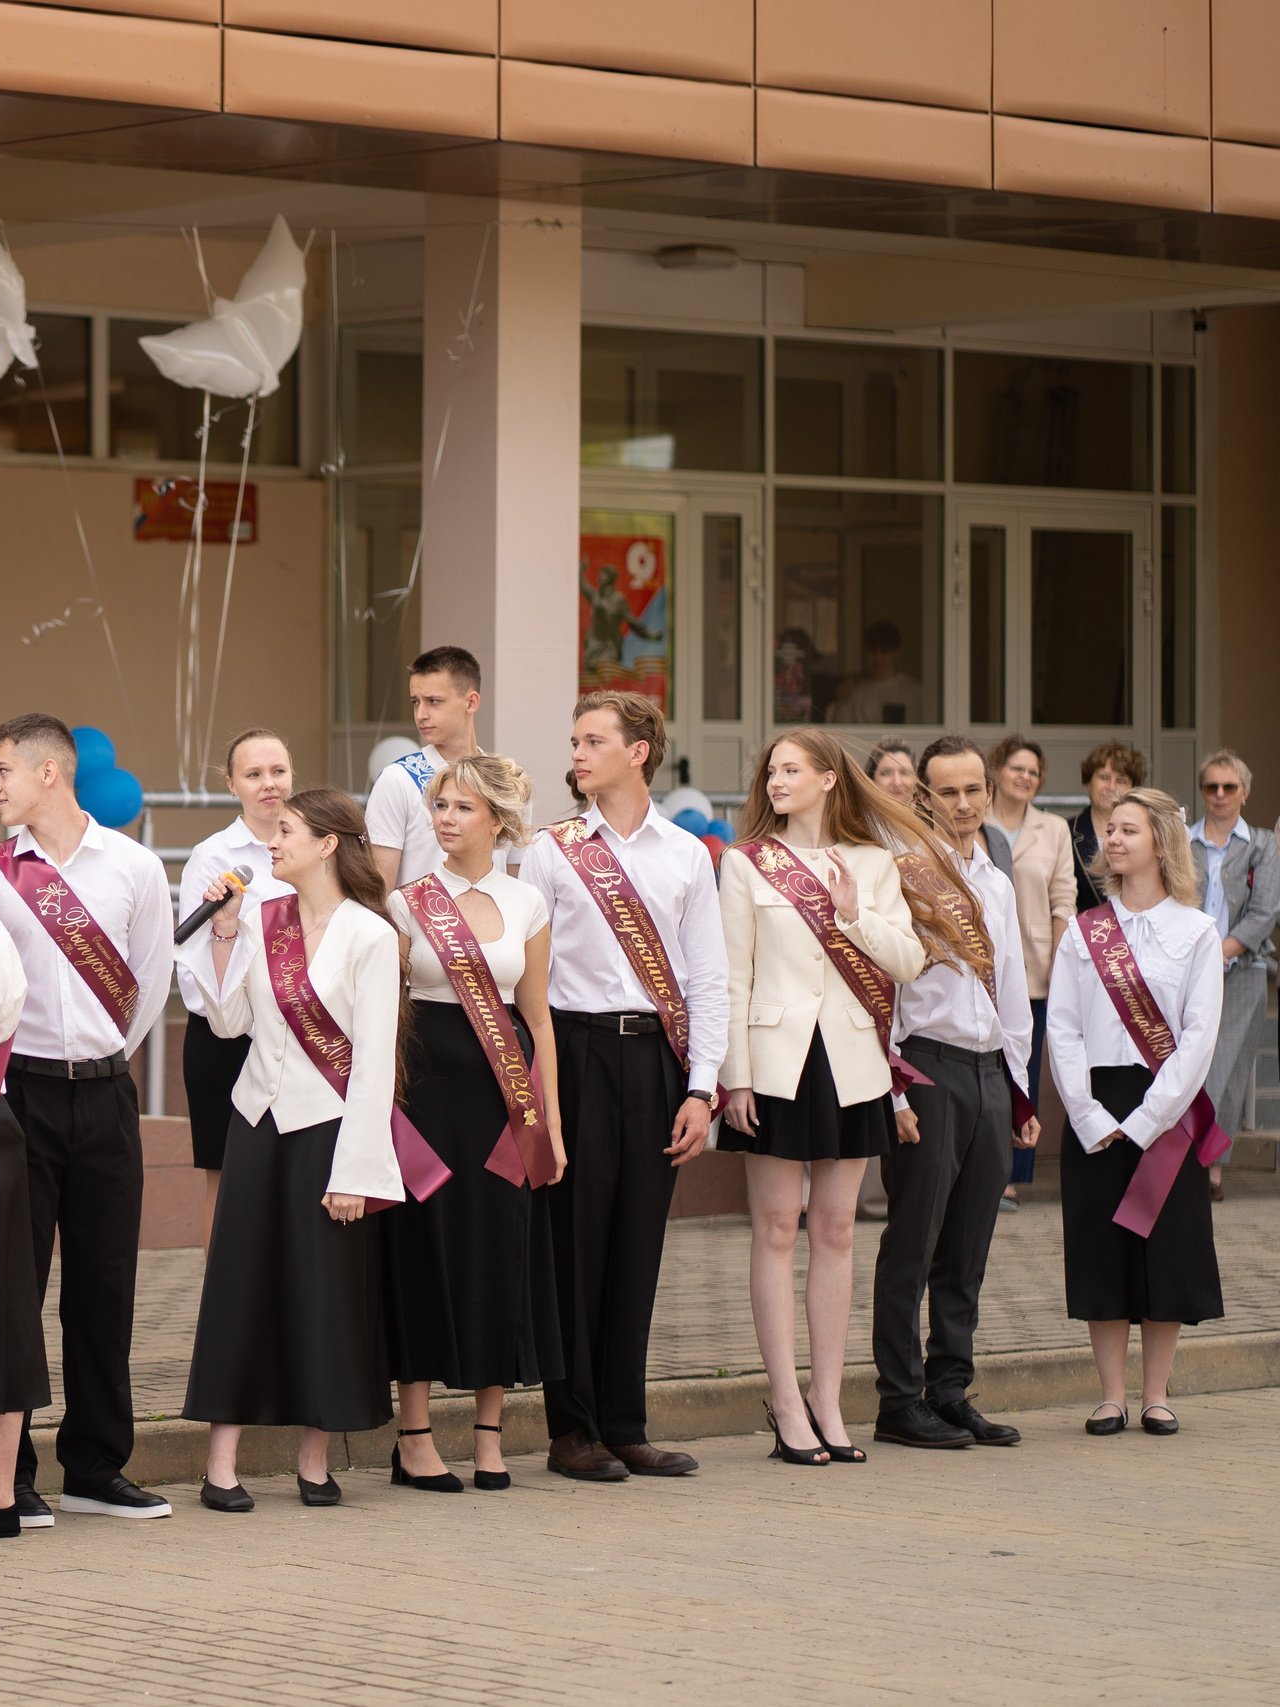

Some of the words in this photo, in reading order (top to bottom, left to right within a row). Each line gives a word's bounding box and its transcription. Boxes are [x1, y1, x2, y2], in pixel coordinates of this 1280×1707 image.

[626, 541, 656, 589] 9
[57, 906, 122, 998] Выпускник
[580, 843, 671, 998] Выпускник
[650, 940, 668, 970] Андрей
[786, 870, 893, 1017] Выпускница
[279, 954, 327, 1052] Выпускница
[420, 889, 506, 1051] Выпускница
[500, 1051, 536, 1104] 2026
[465, 939, 481, 967] Шпак
[476, 963, 500, 1011] Елизавета
[1102, 942, 1150, 1034] Выпускница
